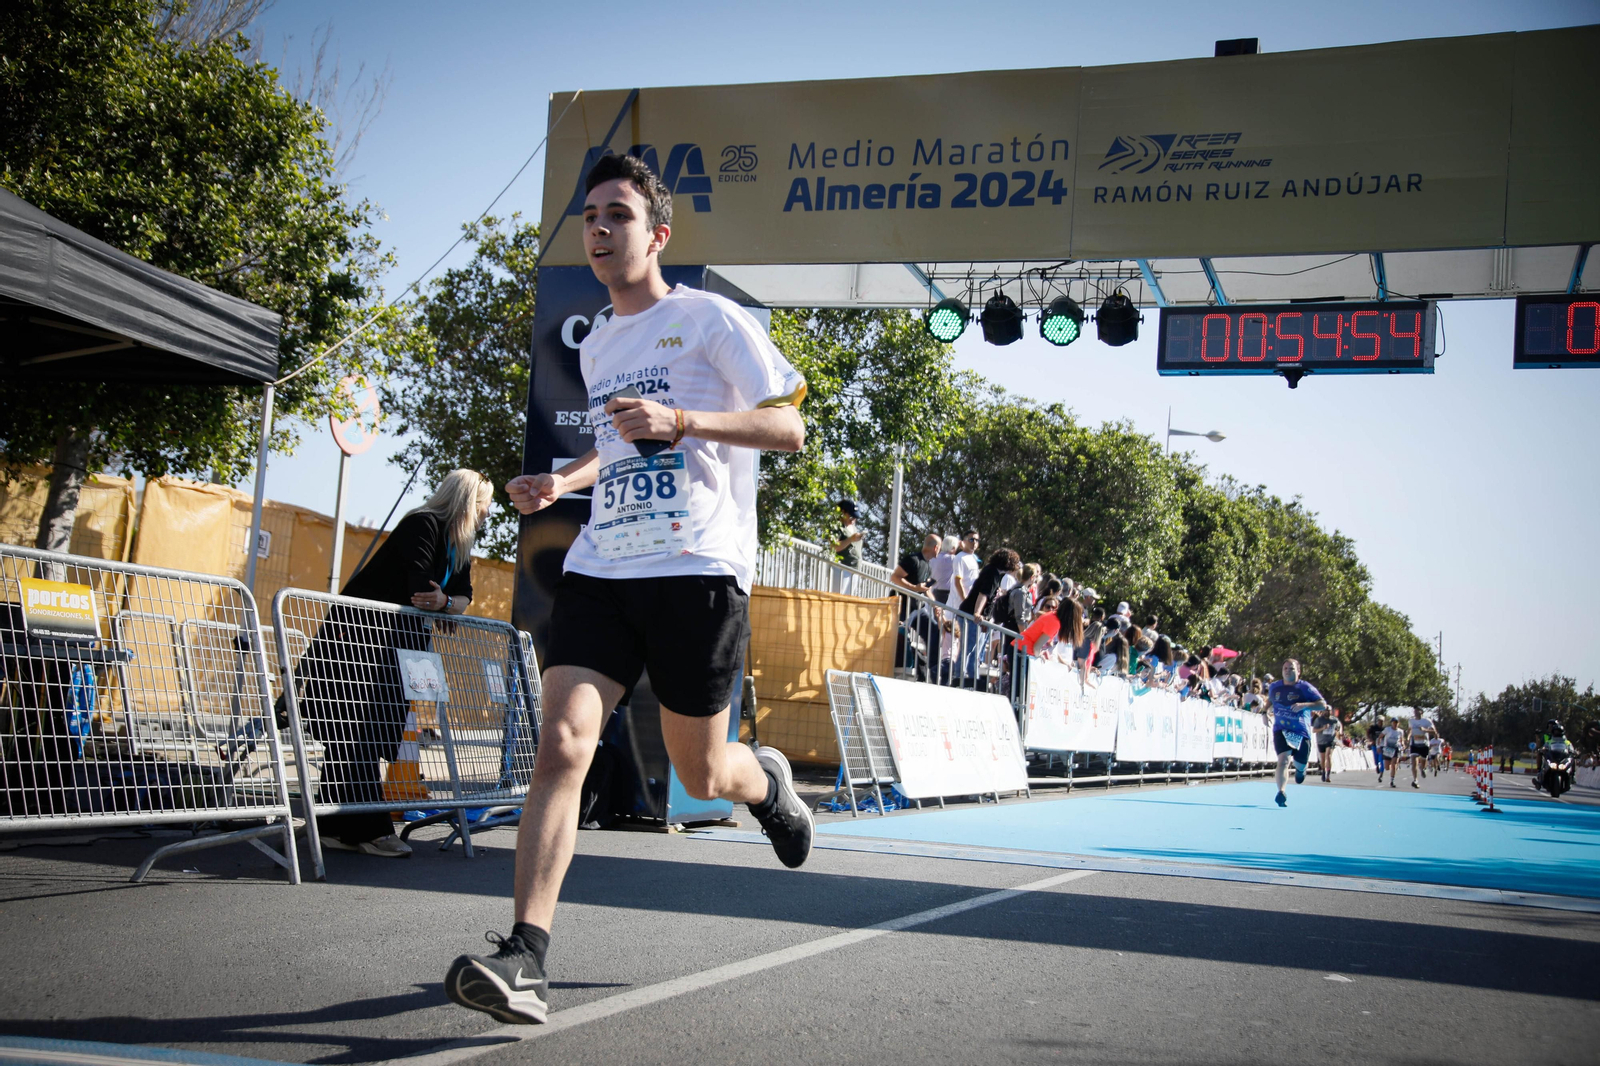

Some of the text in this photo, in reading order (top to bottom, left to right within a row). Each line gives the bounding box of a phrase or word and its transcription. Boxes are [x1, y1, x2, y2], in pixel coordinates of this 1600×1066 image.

[719, 145, 759, 172] 25
[788, 133, 1069, 170] Medio Maratón
[1169, 148, 1236, 161] SERIES
[718, 173, 757, 183] EDICIÓN
[1163, 158, 1273, 173] RUTA RUNNING
[783, 169, 1068, 212] Almería 2024
[1094, 172, 1423, 204] RAMÓN RUIZ ANDÚJAR
[590, 365, 669, 394] edio Maratón
[604, 471, 677, 509] 5798
[617, 501, 653, 514] ANTONIO
[27, 588, 90, 610] portos
